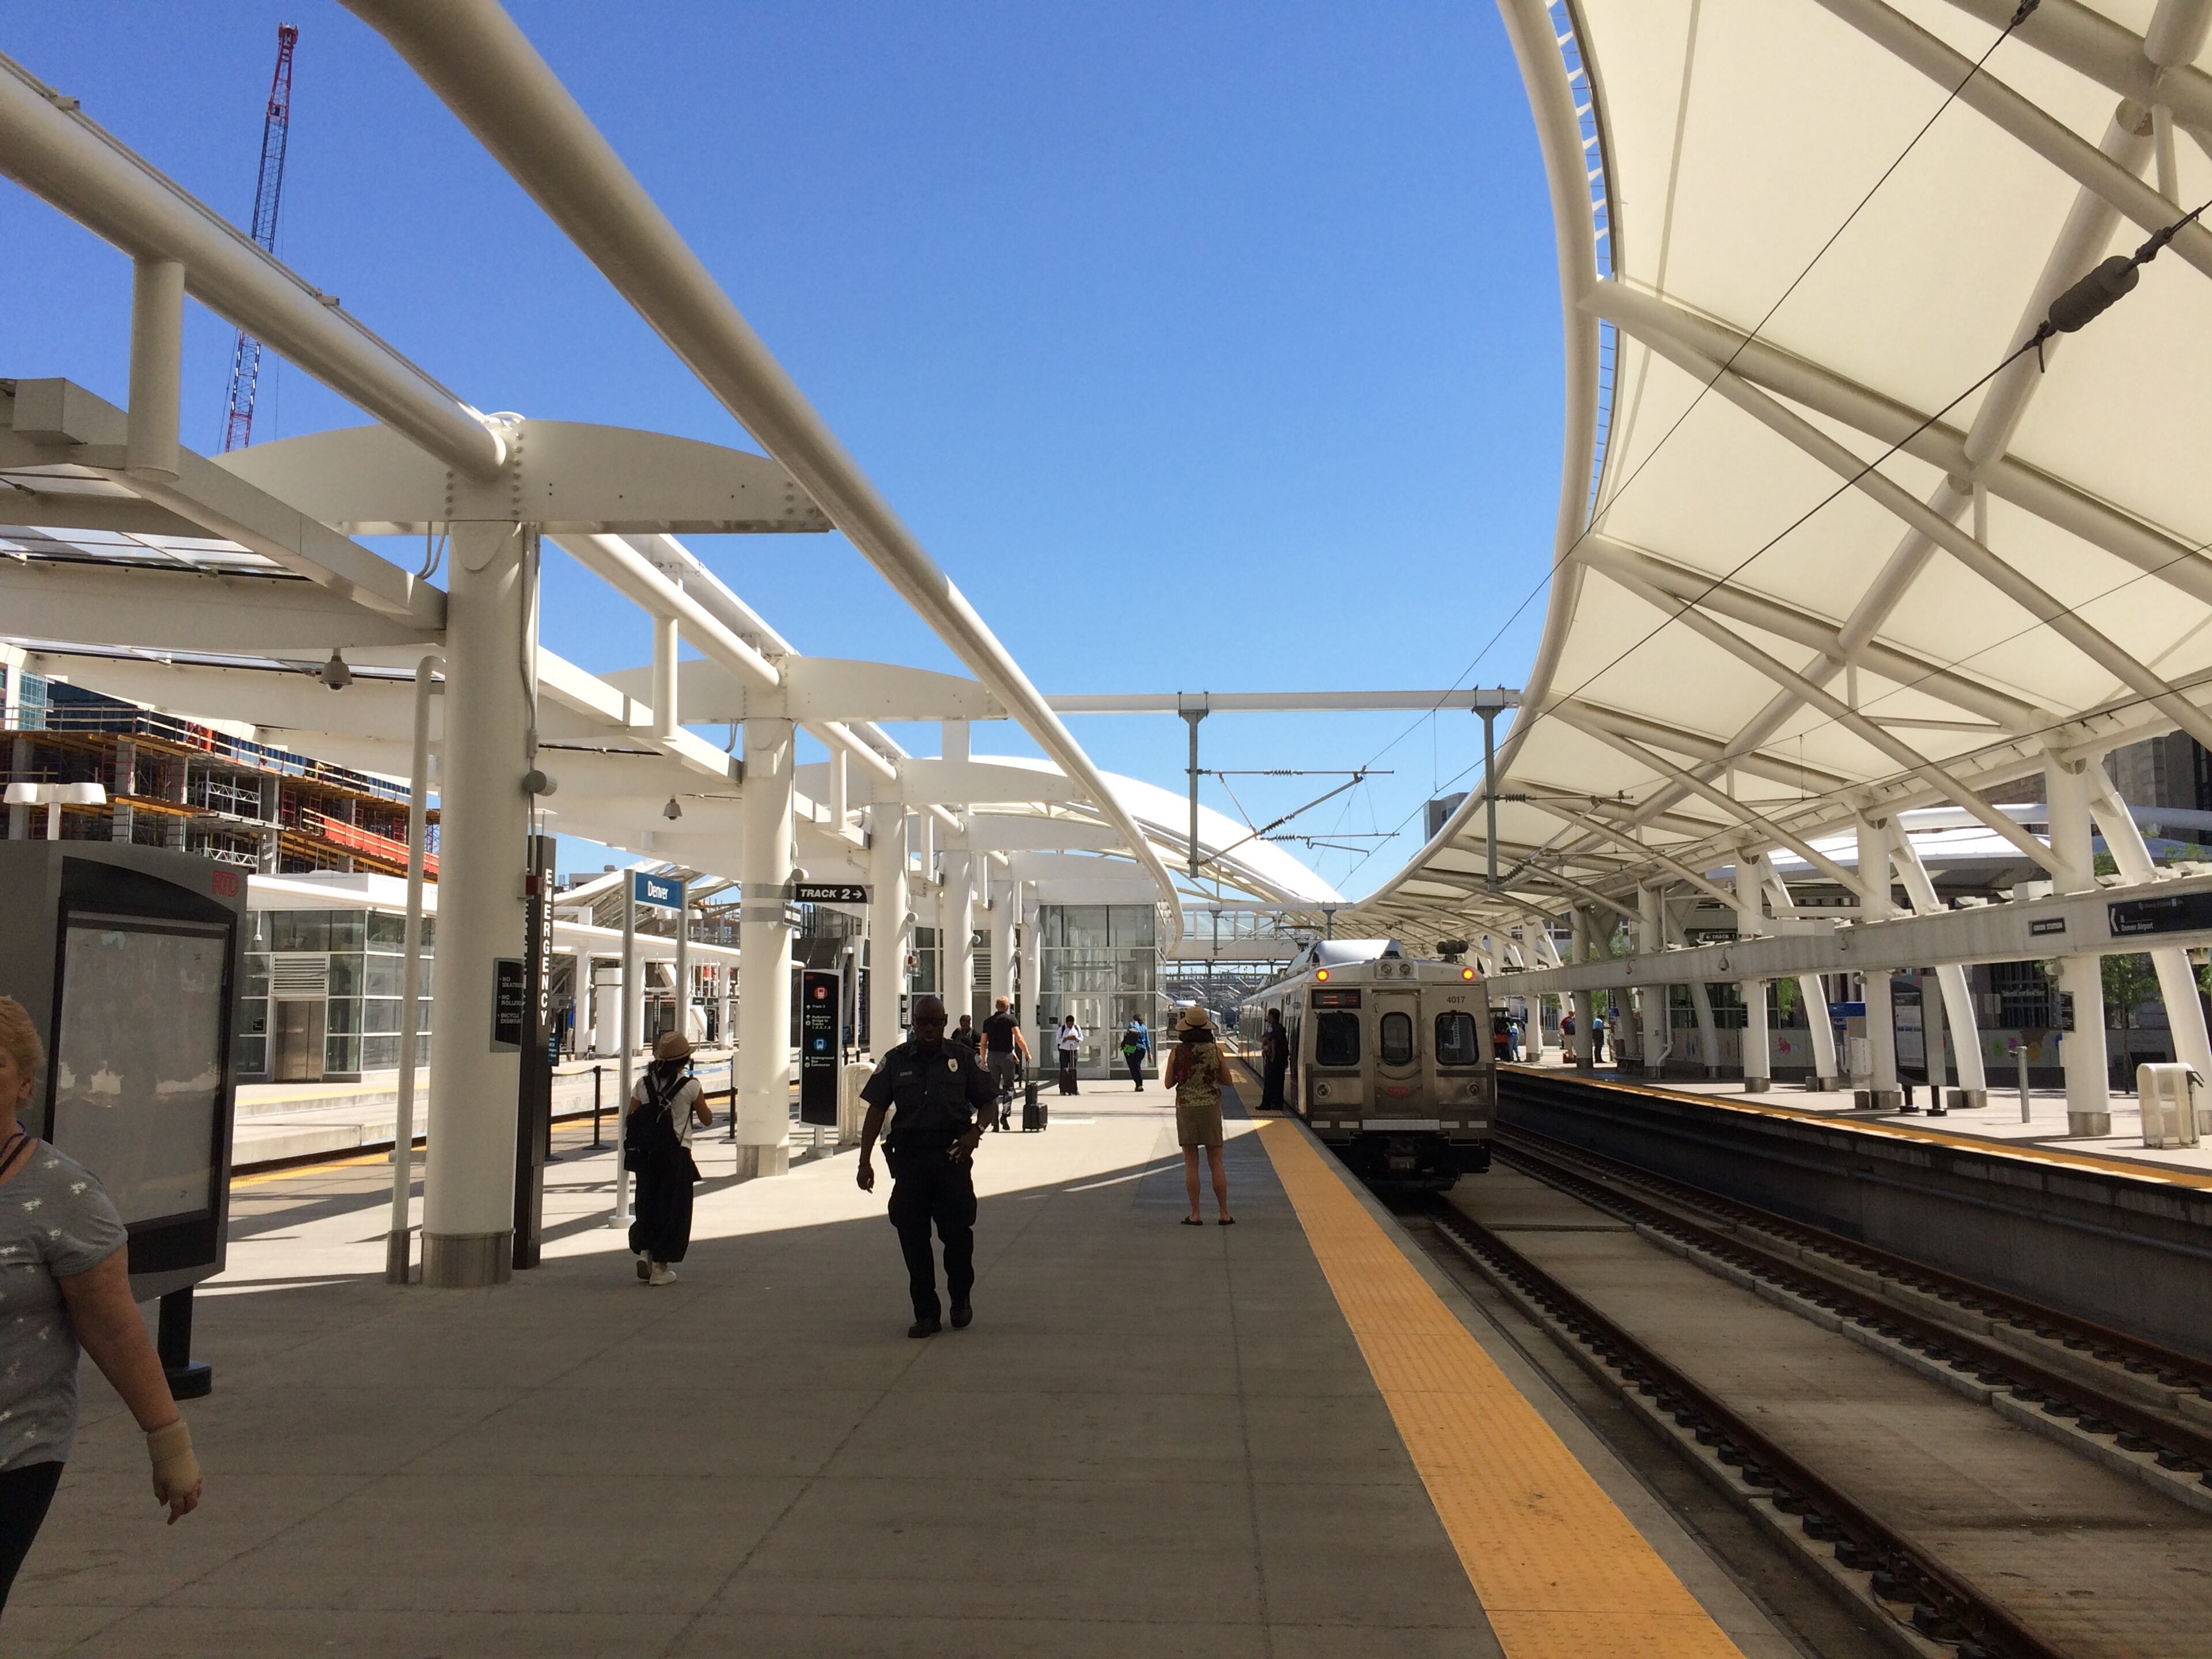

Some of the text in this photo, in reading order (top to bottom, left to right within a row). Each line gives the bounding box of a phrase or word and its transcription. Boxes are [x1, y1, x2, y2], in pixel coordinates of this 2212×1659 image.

[211, 869, 239, 897] RTD
[647, 880, 669, 900] Denver
[800, 888, 851, 899] TRACK 2
[2138, 922, 2154, 931] Airport
[540, 868, 553, 1026] EMERGENCY
[1446, 995, 1466, 1003] 4017
